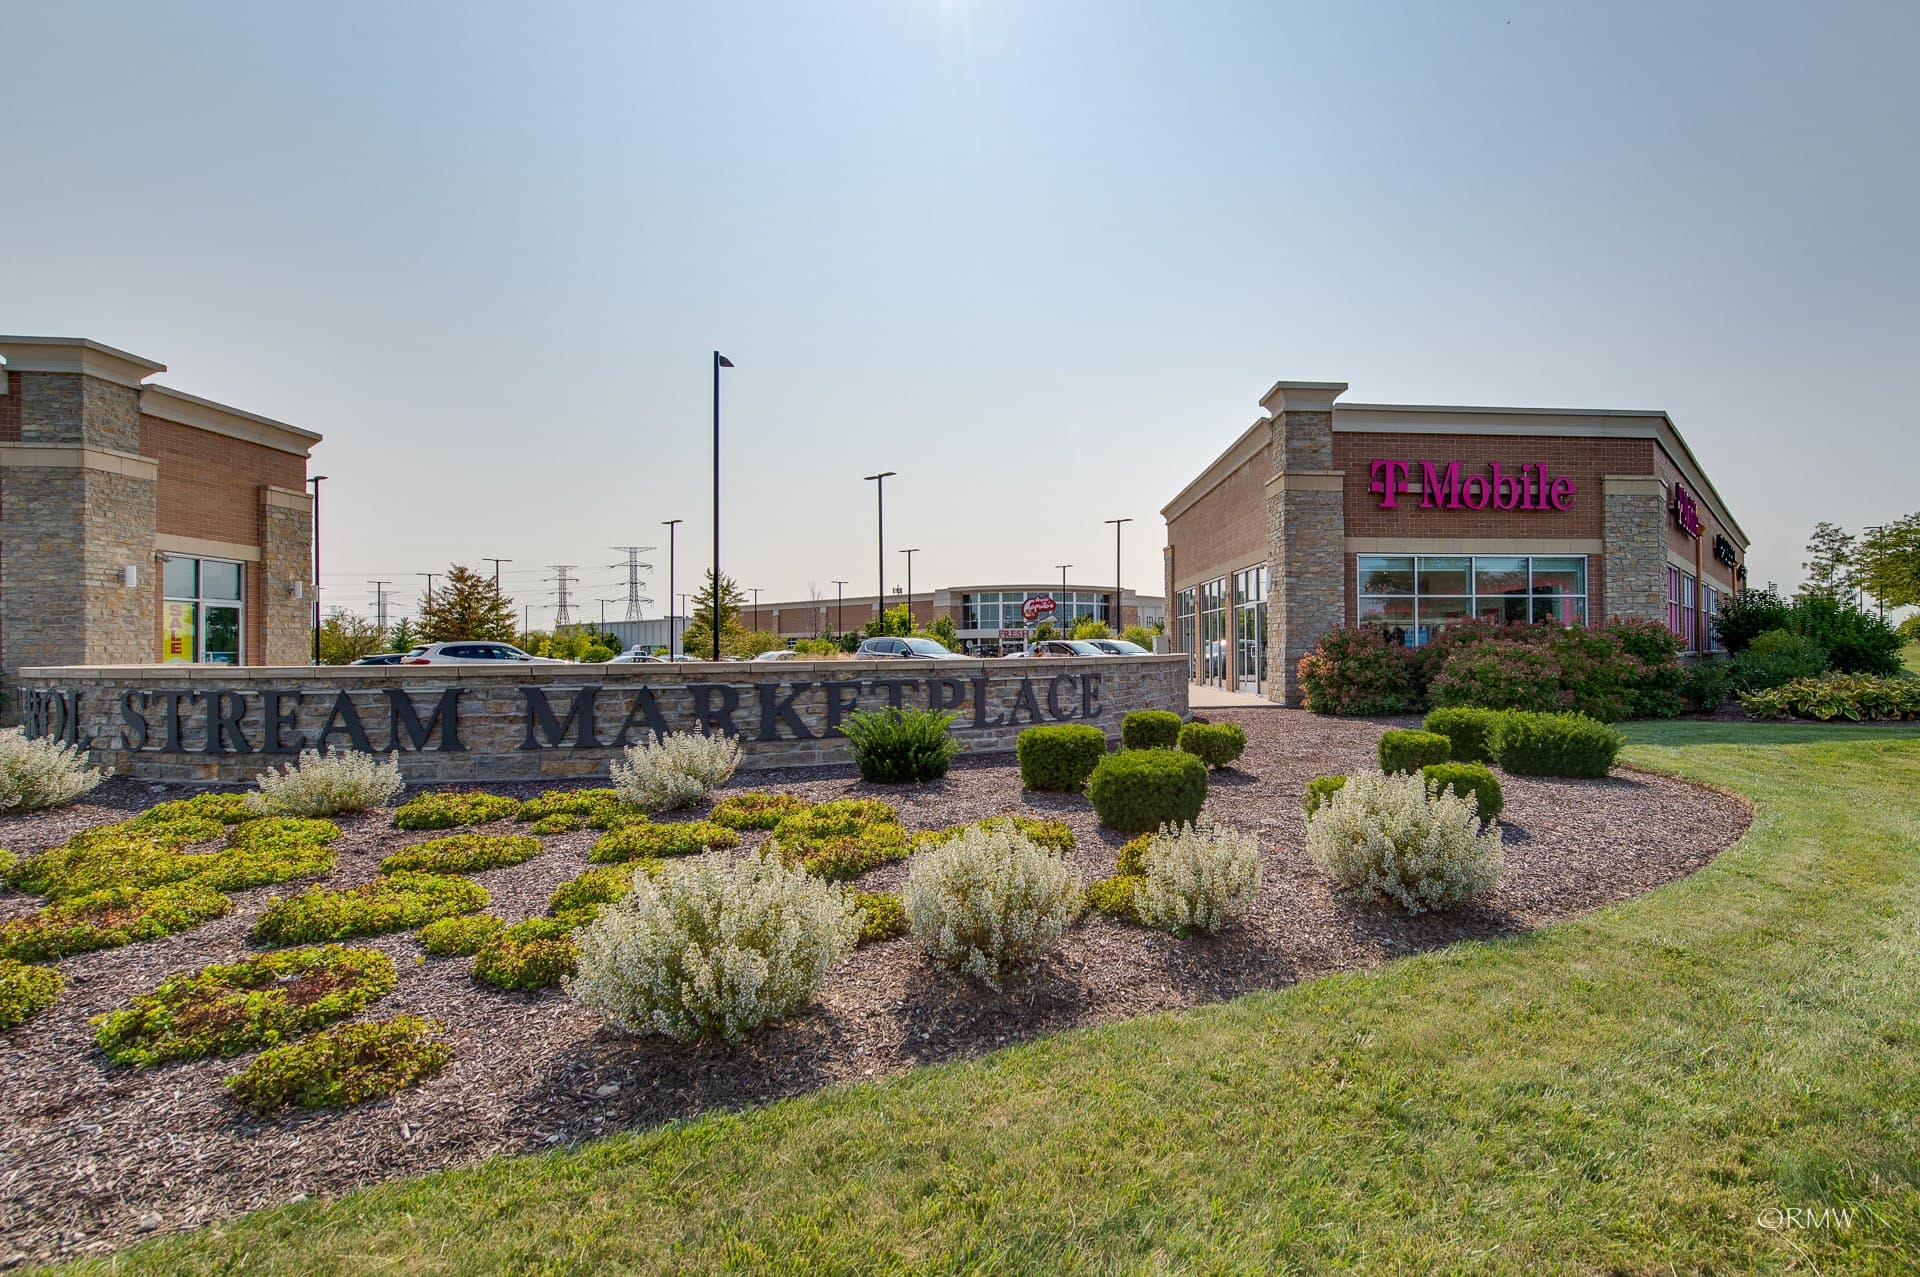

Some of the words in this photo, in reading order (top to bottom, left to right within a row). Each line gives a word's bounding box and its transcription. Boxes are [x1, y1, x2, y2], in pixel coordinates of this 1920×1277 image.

[169, 604, 182, 654] SALE
[998, 629, 1029, 638] FRESH
[119, 687, 467, 753] STREAM
[519, 672, 1103, 750] MARKETPLACE
